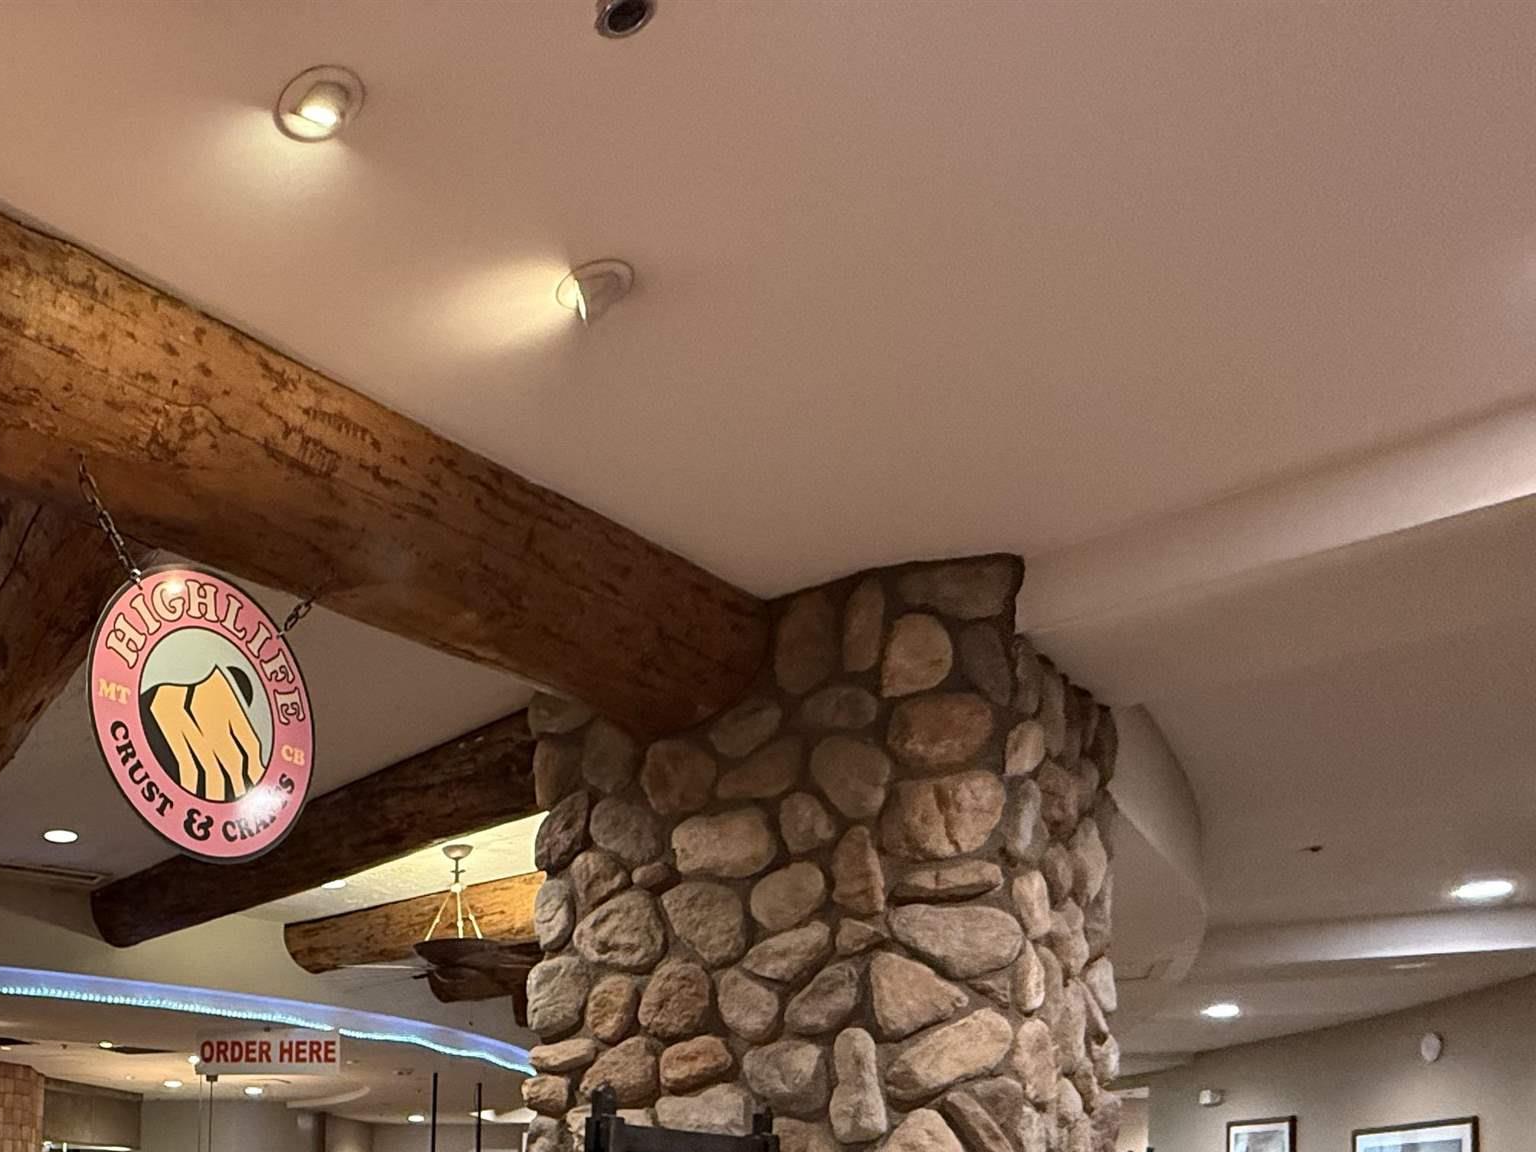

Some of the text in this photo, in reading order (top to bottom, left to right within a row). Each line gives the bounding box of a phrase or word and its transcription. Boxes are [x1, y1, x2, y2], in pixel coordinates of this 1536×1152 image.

[106, 579, 306, 725] HIGHLIFE
[98, 678, 131, 705] MT
[281, 744, 305, 766] CB
[110, 720, 295, 842] CRUST & CRAS
[200, 1040, 336, 1063] ORDER HERE
